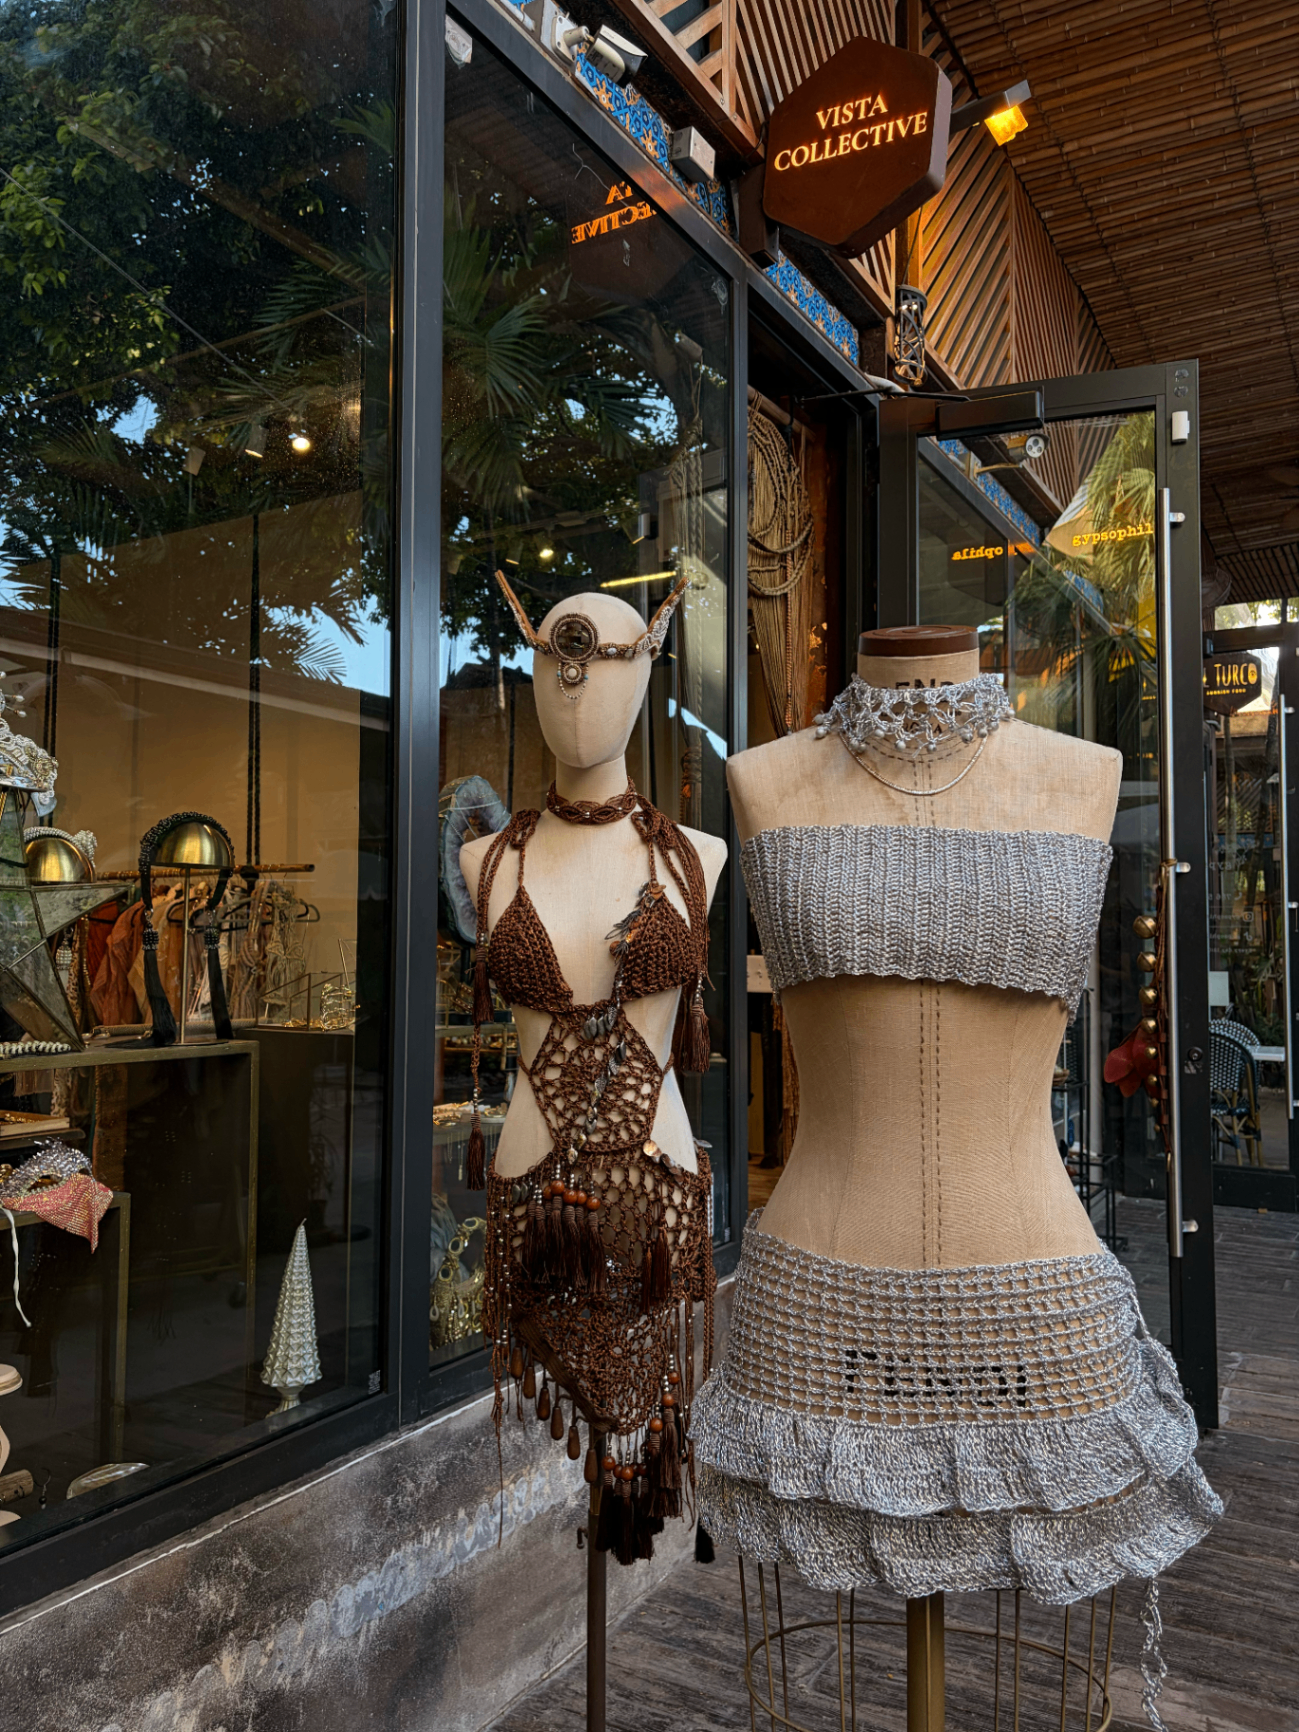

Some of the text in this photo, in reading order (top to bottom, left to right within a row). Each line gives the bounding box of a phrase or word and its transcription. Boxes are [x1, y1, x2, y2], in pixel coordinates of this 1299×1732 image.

[815, 93, 888, 130] VISTA
[773, 111, 929, 172] COLLECTIVE
[1072, 522, 1154, 548] gypsophil
[1213, 662, 1258, 687] TURCO
